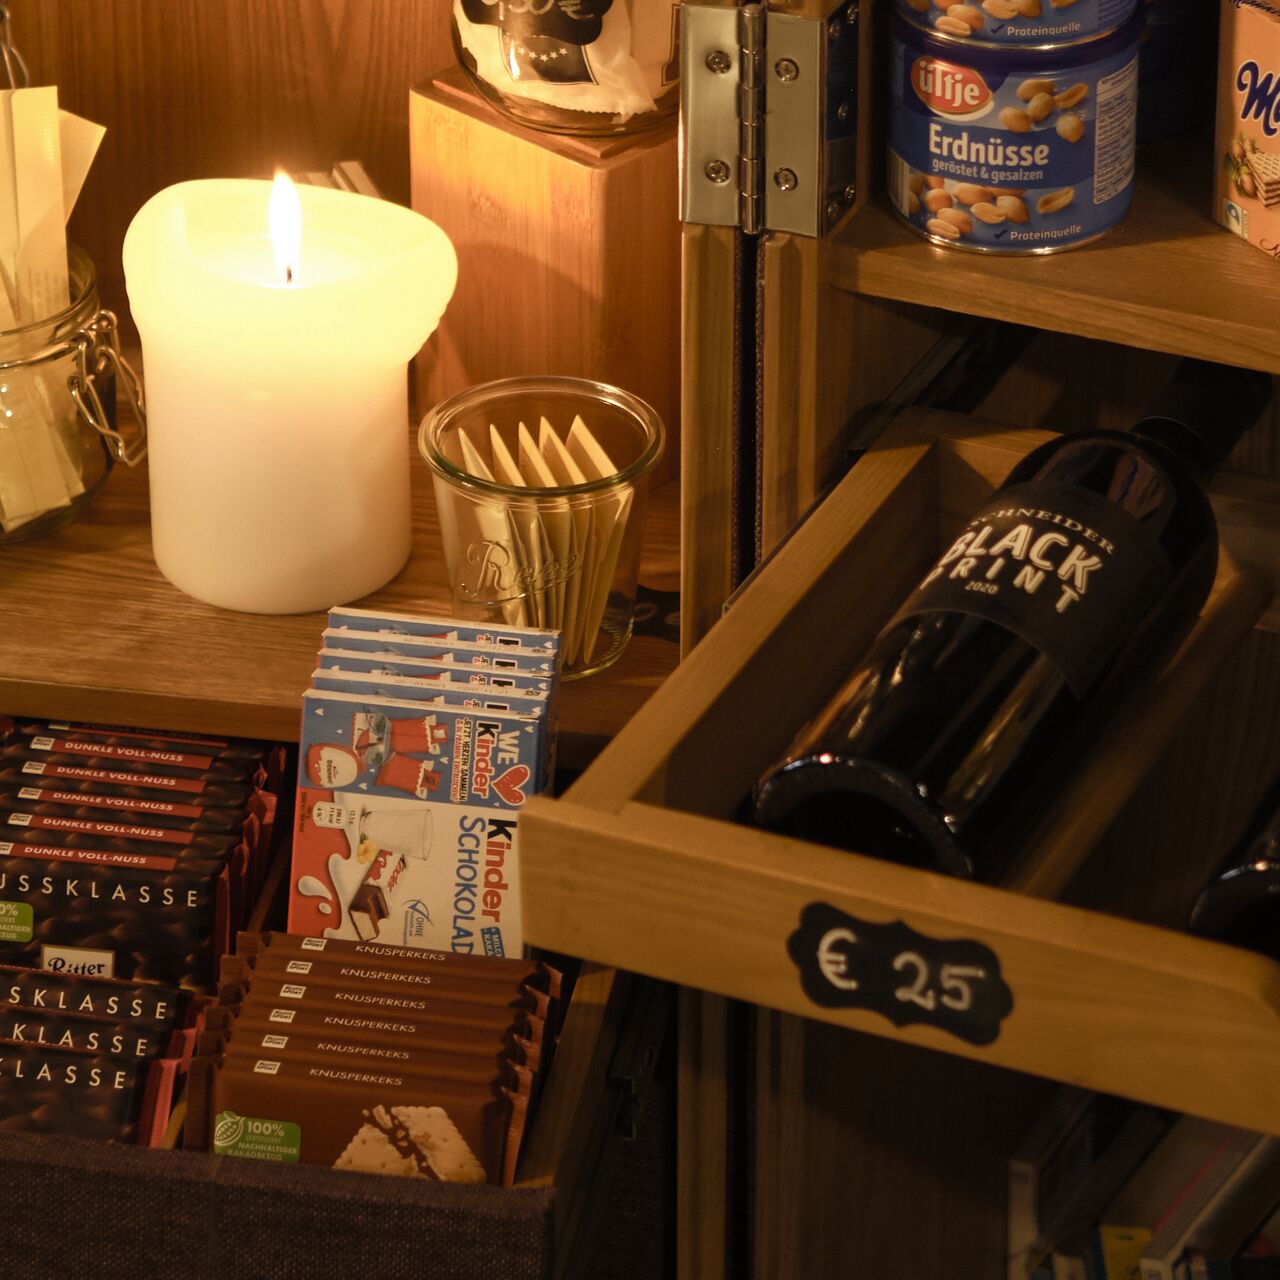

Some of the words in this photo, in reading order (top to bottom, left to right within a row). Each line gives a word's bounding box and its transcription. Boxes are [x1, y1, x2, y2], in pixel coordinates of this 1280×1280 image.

[1007, 22, 1081, 37] Proteinquelle
[919, 60, 980, 108] ültje
[928, 122, 1050, 167] Erdnüsse
[932, 158, 978, 178] geröstet
[980, 166, 990, 180] &
[991, 167, 1044, 184] gesalzen
[1009, 224, 1082, 241] Proteinquelle
[937, 524, 1103, 596] BLACK
[64, 742, 113, 754] DUNKLE
[116, 748, 184, 763] VOLL-NUSS
[497, 730, 520, 765] WE
[56, 765, 106, 779] DUNKLE
[108, 771, 177, 787] VOLL-NUSS
[52, 791, 102, 805] DUNKLE
[104, 798, 174, 813] VOLL-NUSS
[42, 817, 91, 831] DUNKLE
[94, 824, 165, 839] VOLL-NUSS
[23, 845, 74, 858] DUNKLE
[76, 852, 148, 865] VOLL-NUSS
[414, 916, 425, 938] OHNE
[355, 944, 447, 962] KNUSPERKEKS
[340, 966, 432, 984] KNUSPERKEKS
[816, 926, 859, 991] €
[892, 951, 987, 1012] 25
[334, 991, 427, 1010] KNUSPERKEKS
[324, 1016, 417, 1033] KNUSPERKEKS
[317, 1041, 410, 1060] KNUSPERKEKS
[309, 1067, 403, 1086] KNUSPERKEKS
[246, 1121, 287, 1138] 100%
[237, 1142, 297, 1155] NACHHALTIGER
